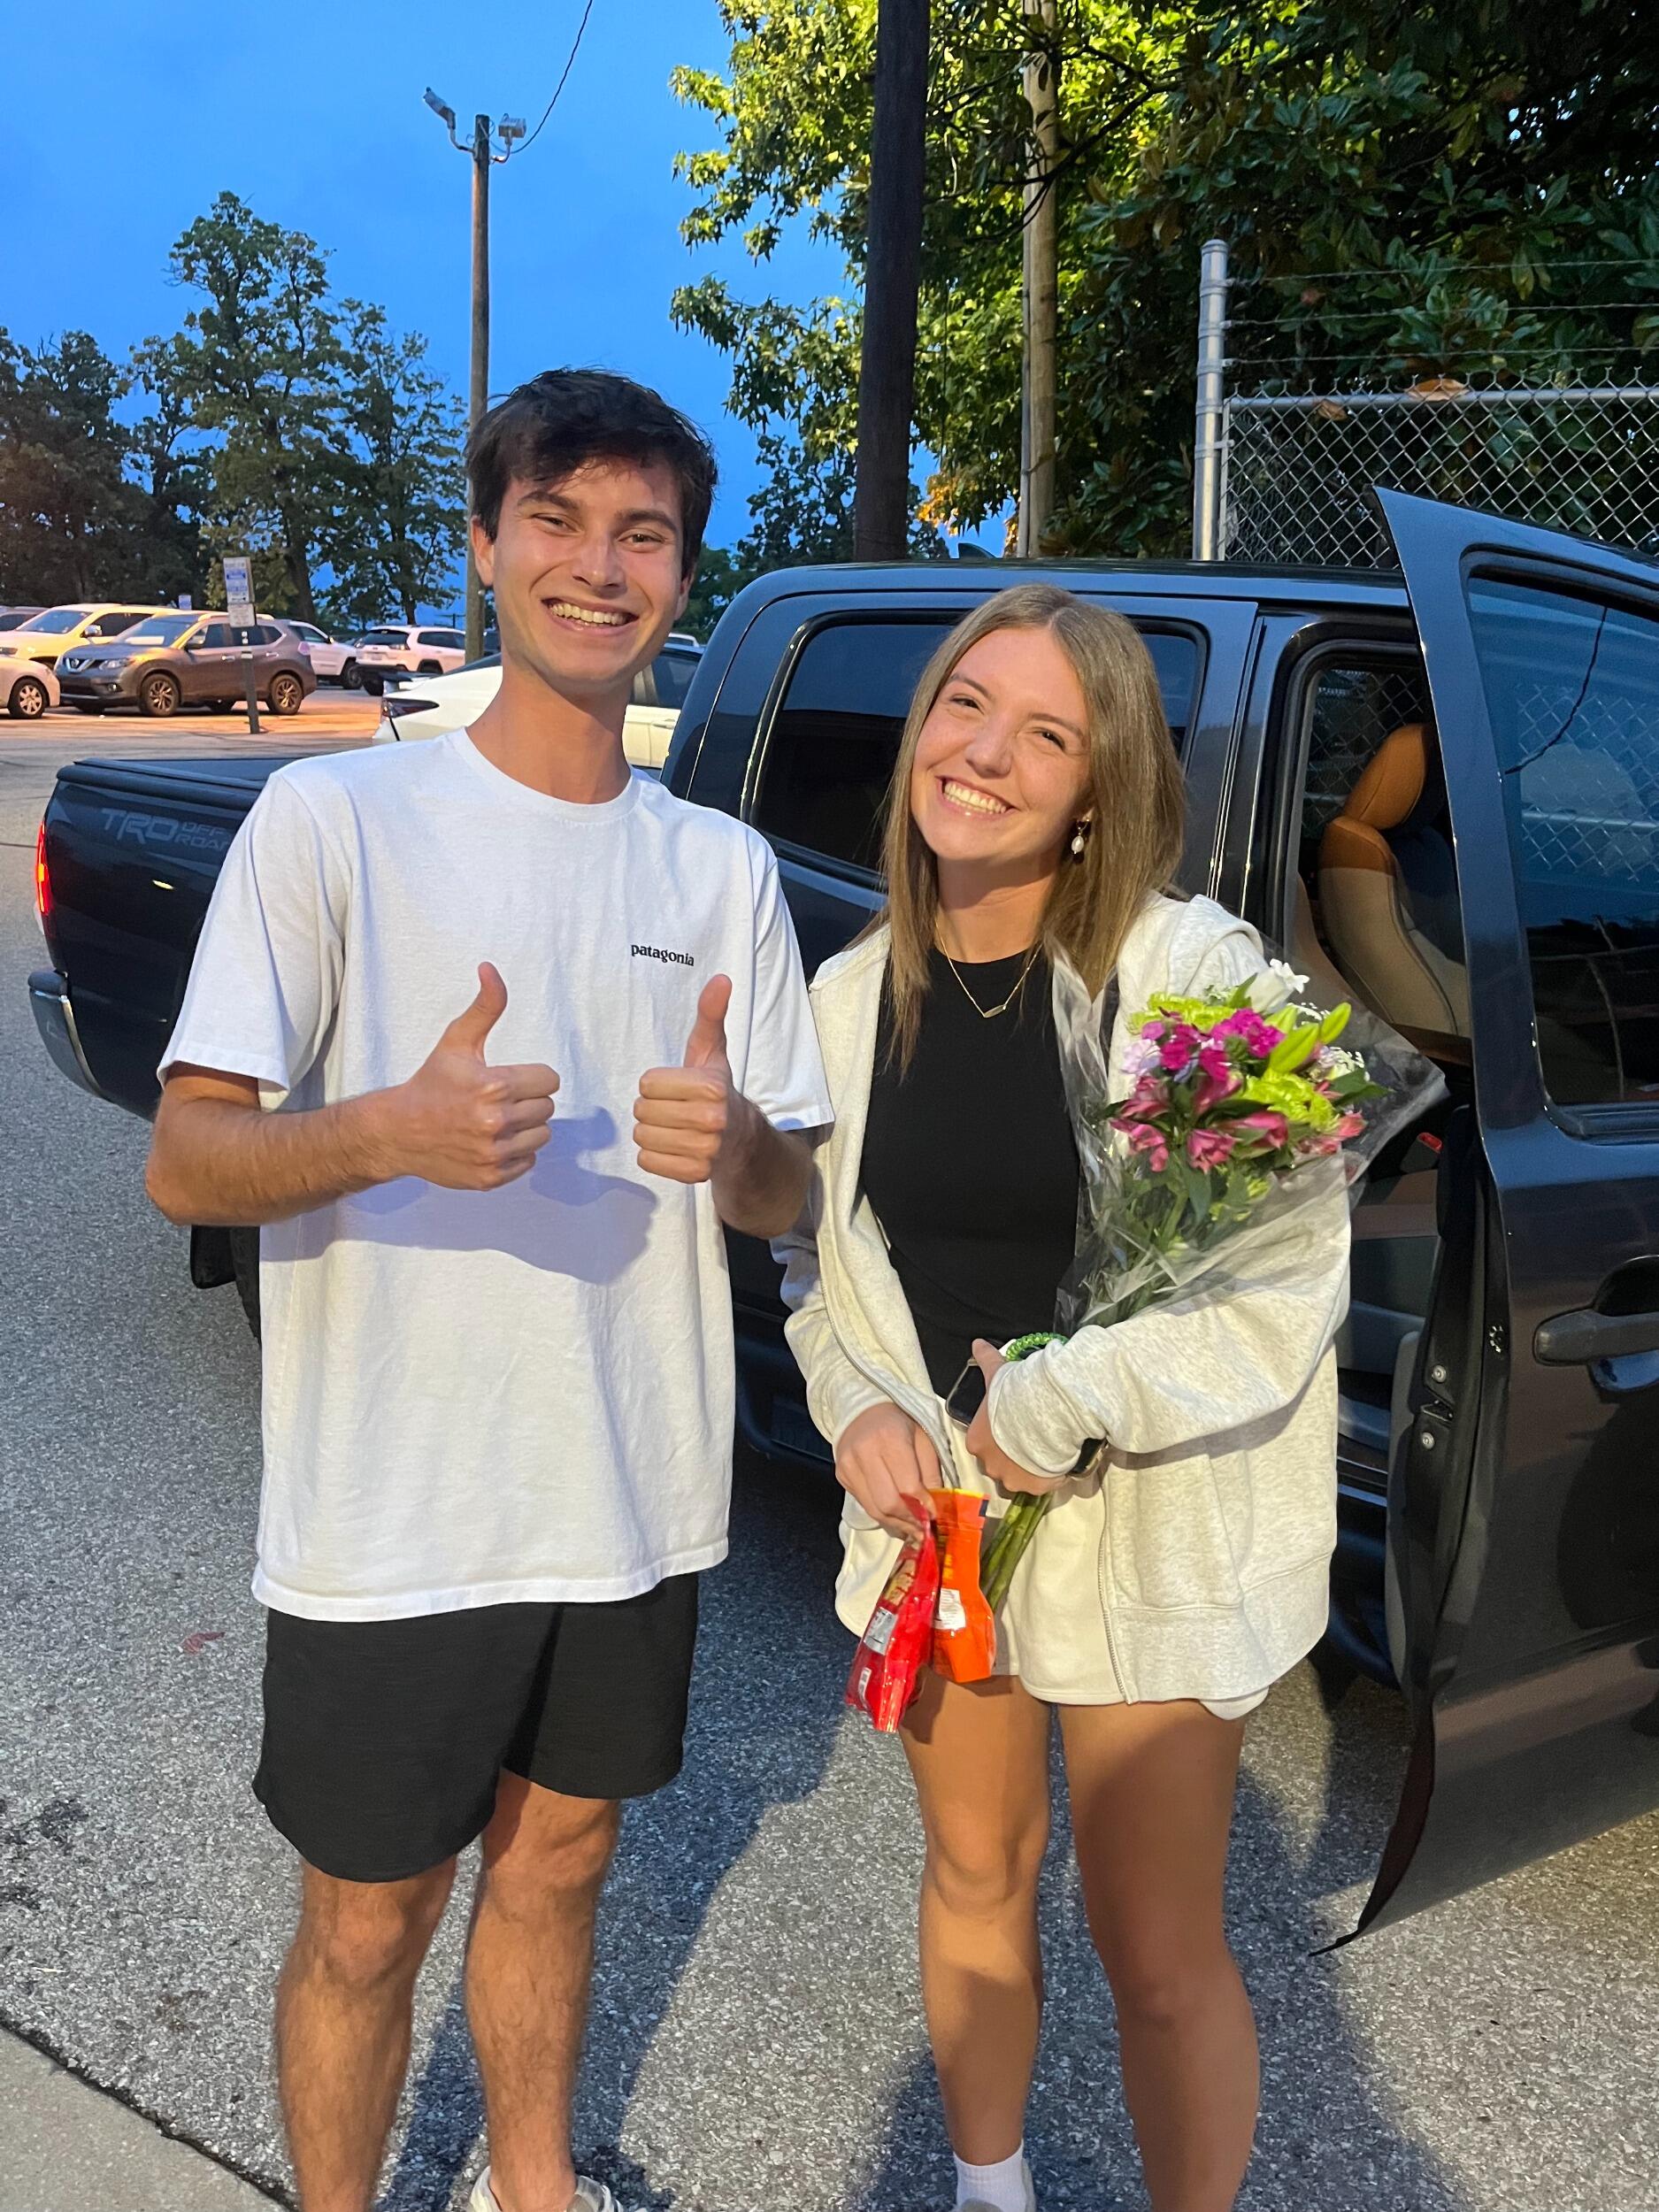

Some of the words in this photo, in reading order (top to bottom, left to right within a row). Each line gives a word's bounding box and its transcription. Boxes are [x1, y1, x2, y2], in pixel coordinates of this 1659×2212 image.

[102, 808, 179, 844] TRD
[181, 822, 227, 836] OFF
[631, 944, 695, 966] patagonia
